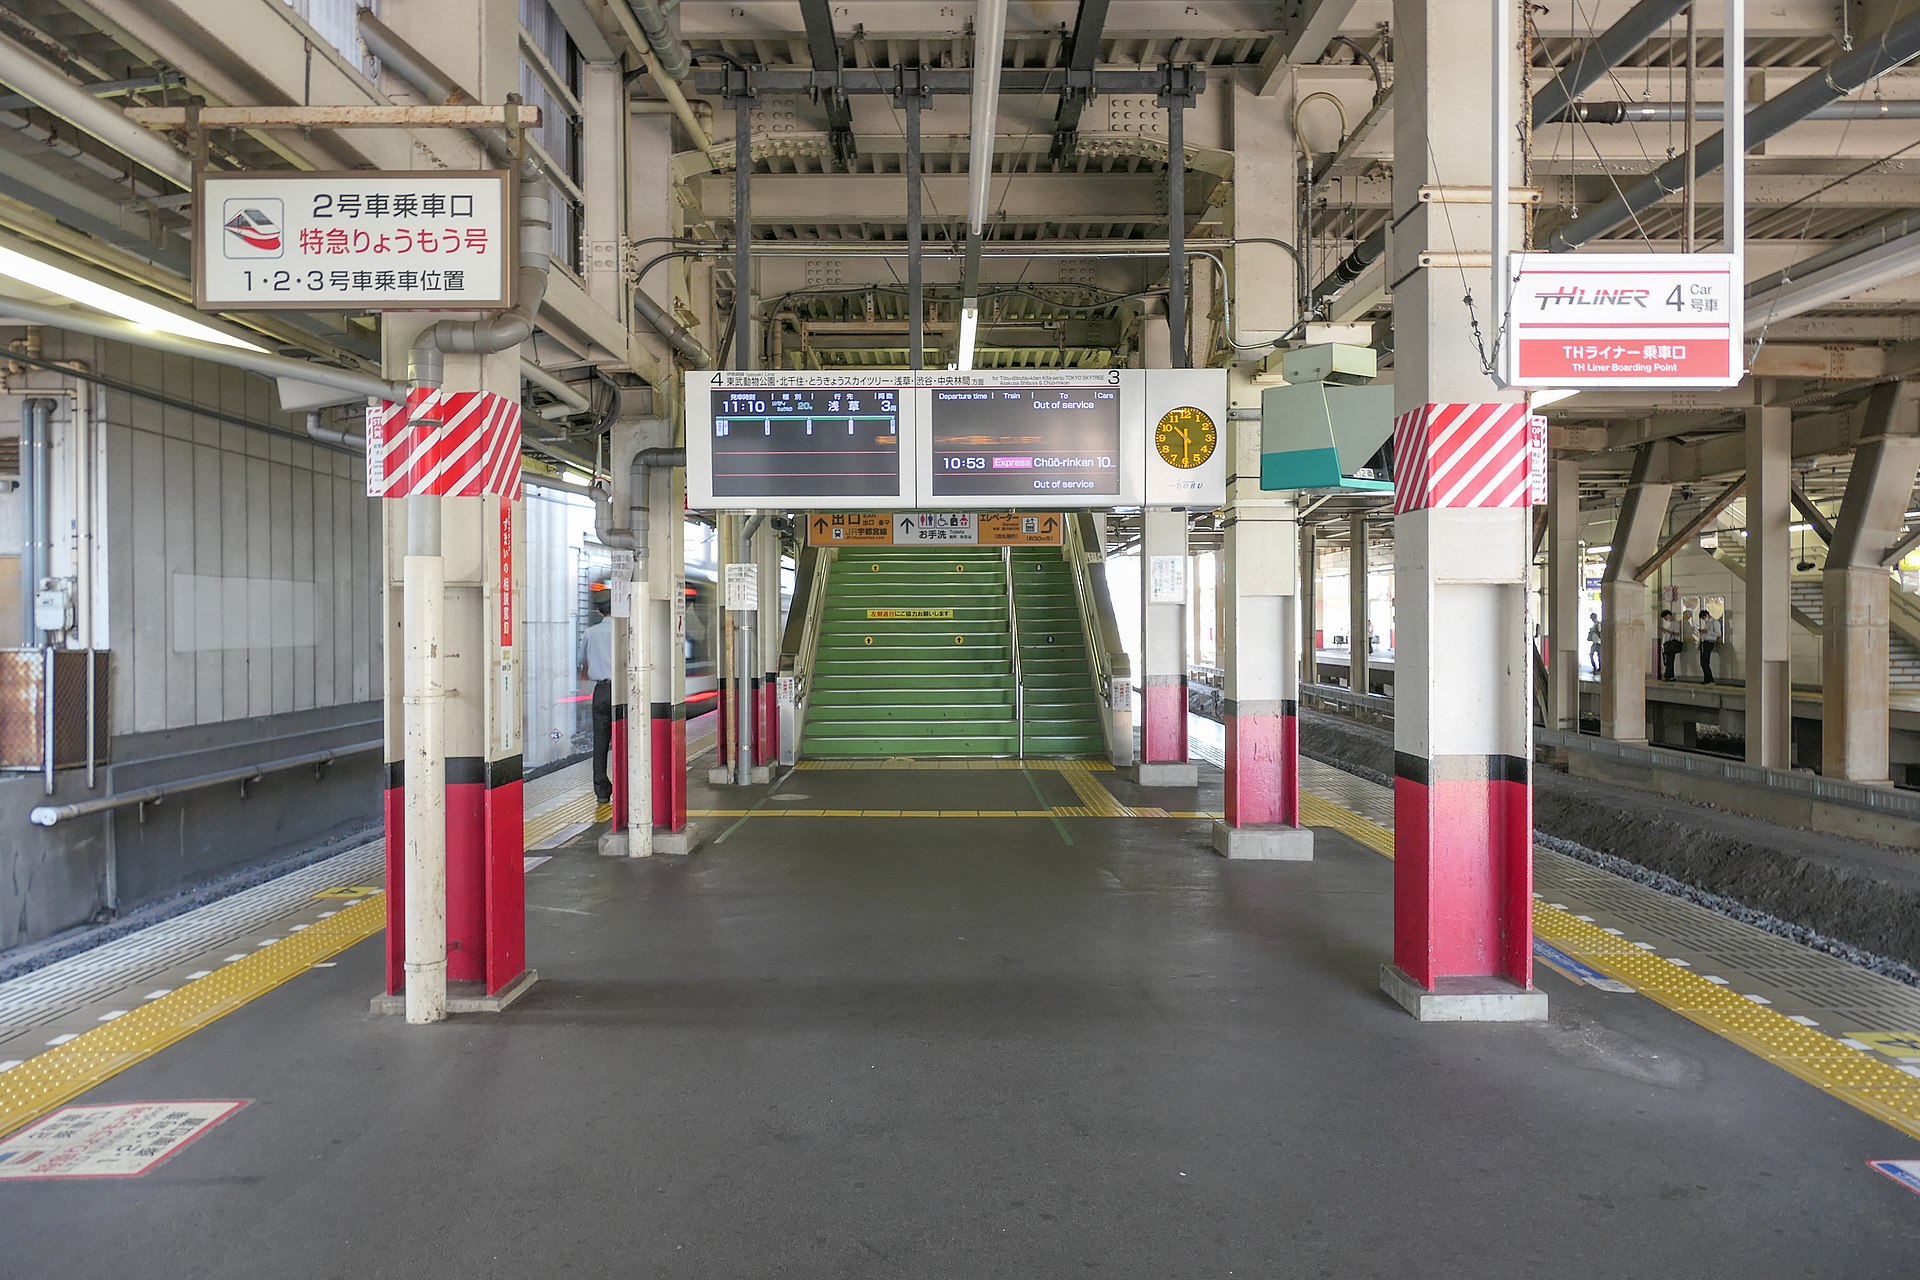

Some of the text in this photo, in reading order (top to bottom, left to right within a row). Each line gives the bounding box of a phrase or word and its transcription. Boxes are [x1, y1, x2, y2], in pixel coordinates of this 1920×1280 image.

[312, 193, 473, 218] 2号車乗車口
[299, 228, 488, 254] 特急りょうもう号
[243, 269, 465, 291] 1・2・3号車乗車位置
[1690, 284, 1712, 295] Car
[1665, 284, 1685, 312] 4
[1690, 298, 1719, 313] 号車
[1562, 345, 1687, 360] THライナー 乗車口
[1572, 363, 1678, 374] TH Liner Boarding Point
[710, 372, 724, 387] 4
[1108, 371, 1121, 385] 3
[938, 393, 972, 401] Departure
[722, 400, 766, 413] 11:10
[1033, 401, 1095, 409] Out of service
[1169, 415, 1179, 423] 11
[1179, 410, 1192, 419] 12
[1195, 414, 1201, 423] 1
[1161, 423, 1173, 432] 10
[1201, 422, 1210, 431] 2
[1158, 433, 1167, 443] 9
[1204, 433, 1213, 443] 3
[1162, 444, 1170, 453] 8
[1200, 444, 1208, 453] 4
[1170, 453, 1178, 462] 7
[1181, 456, 1189, 465] 6
[1193, 453, 1201, 462] 5
[943, 457, 986, 469] 10:53
[993, 458, 1032, 468] Express
[1033, 480, 1095, 489] Out of service
[832, 514, 861, 526] 出口
[979, 513, 1020, 522] エレベーター
[918, 529, 947, 540] お手洗
